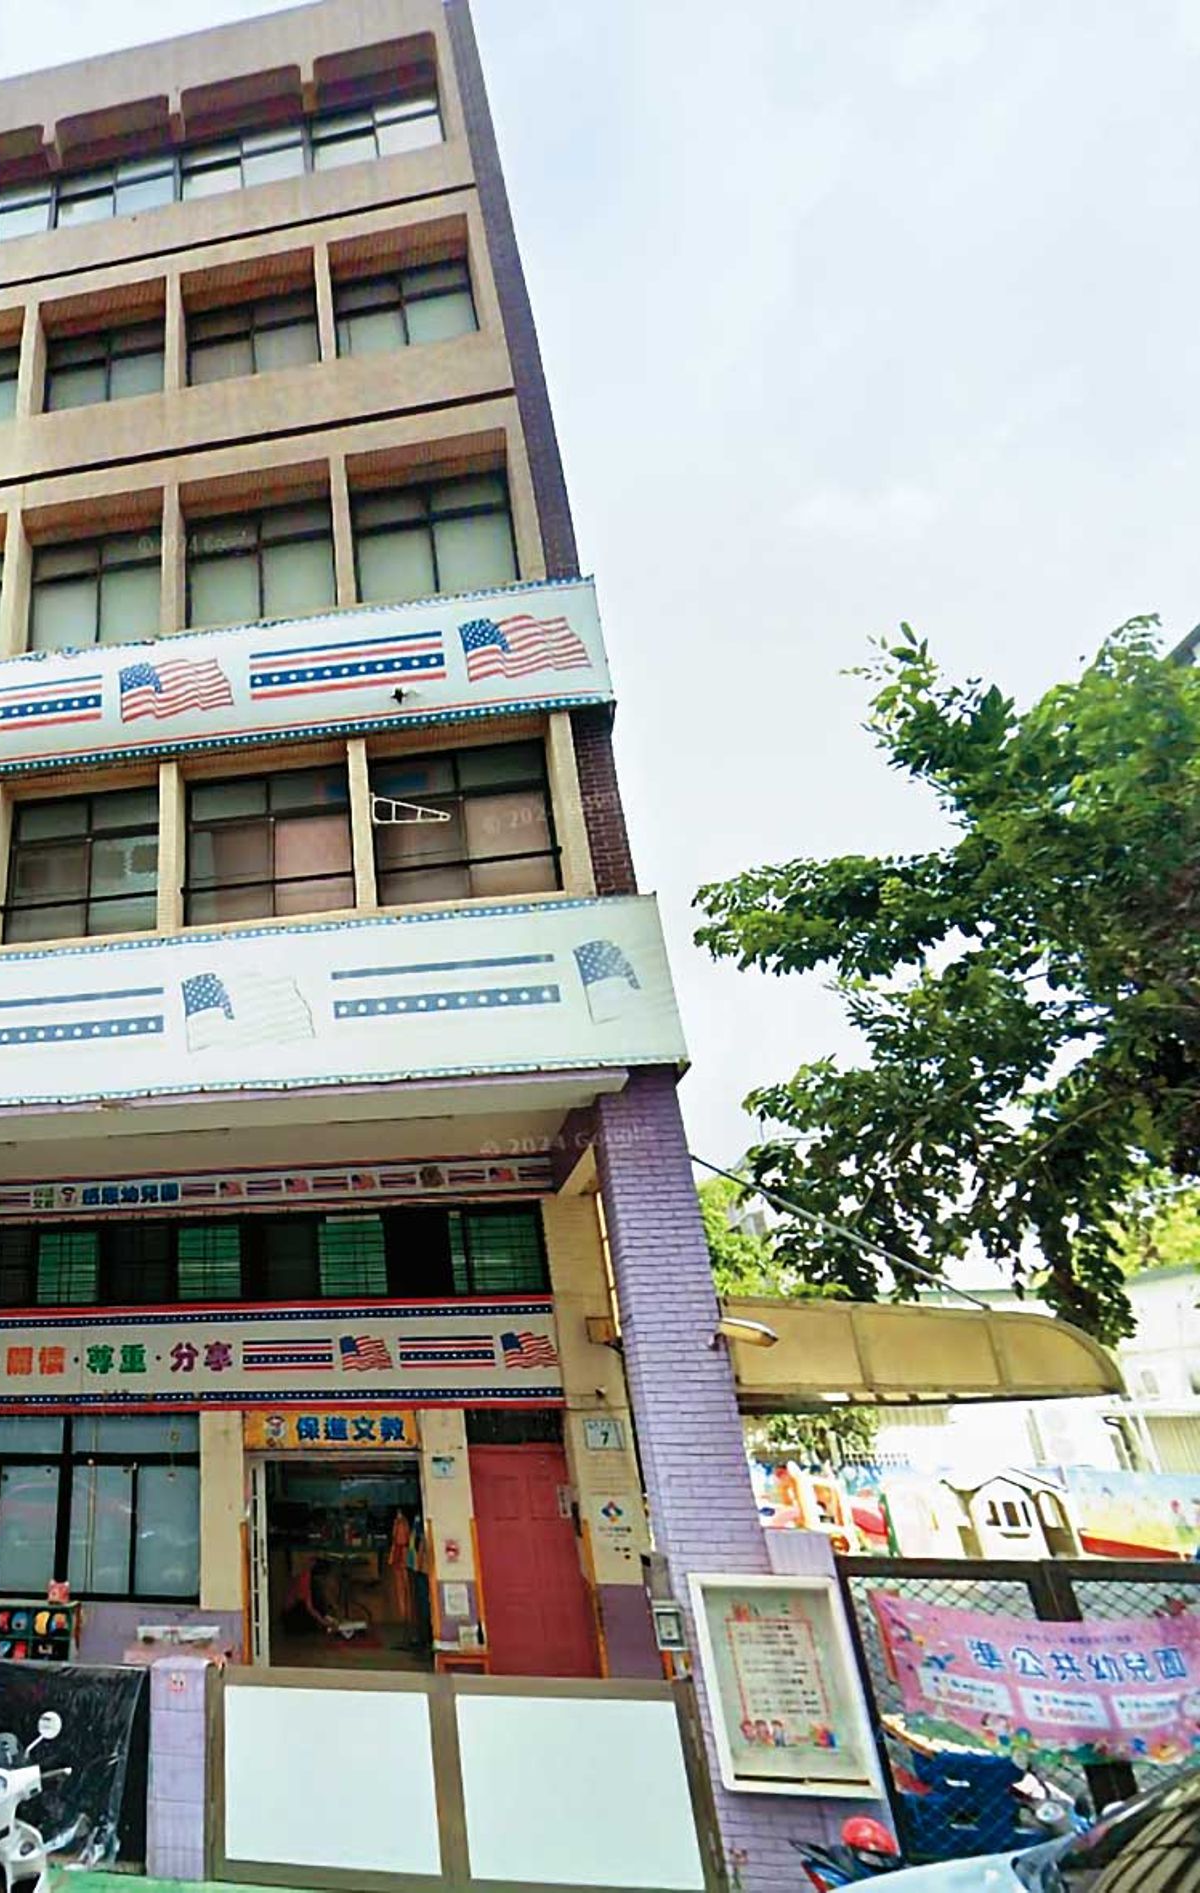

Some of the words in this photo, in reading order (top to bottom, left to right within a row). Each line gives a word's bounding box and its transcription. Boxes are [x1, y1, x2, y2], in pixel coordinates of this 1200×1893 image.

[967, 1638, 1188, 1683] 準公共幼兒園
